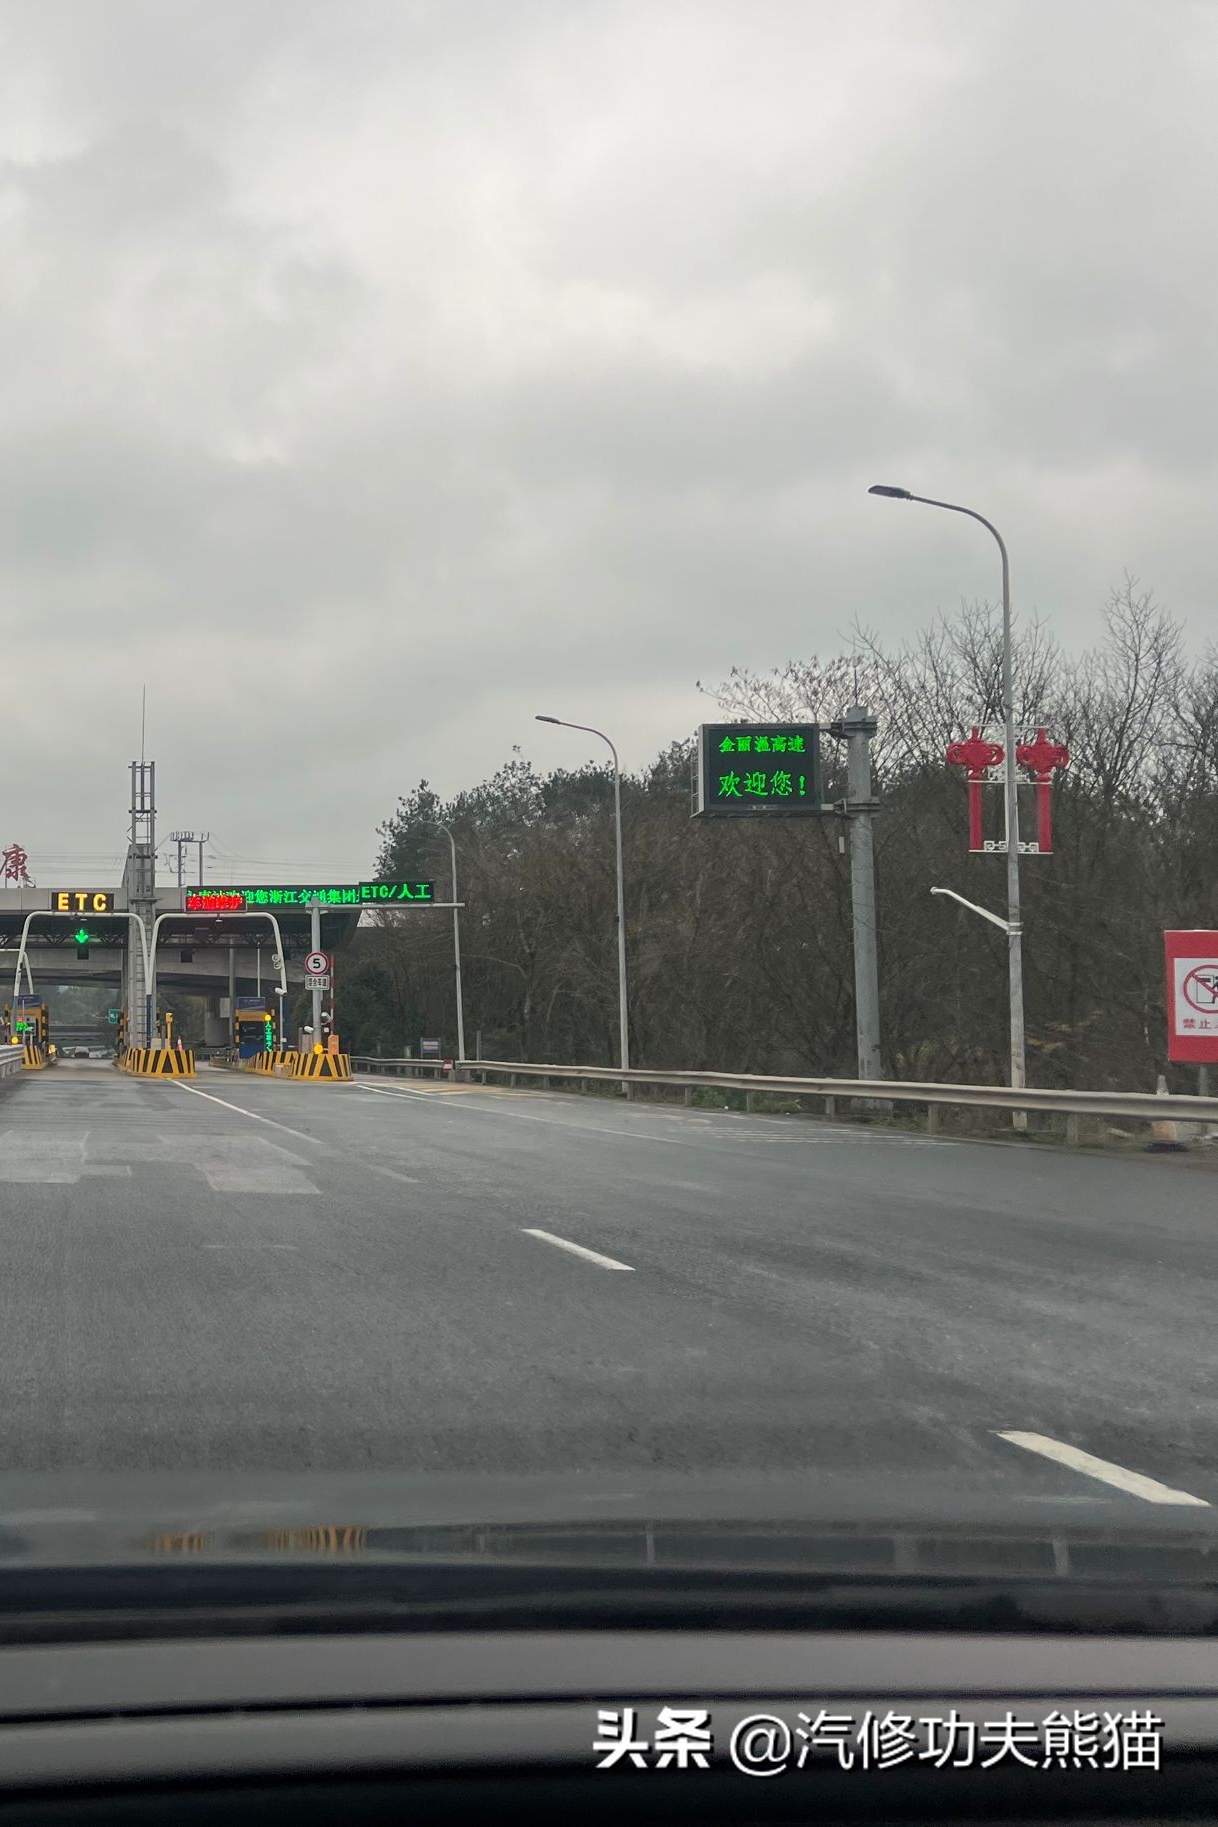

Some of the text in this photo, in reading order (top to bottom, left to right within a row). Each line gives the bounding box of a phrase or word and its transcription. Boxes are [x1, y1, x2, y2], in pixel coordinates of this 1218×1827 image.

[719, 734, 806, 753] 金丽温高速
[718, 770, 806, 797] 欢迎您！
[361, 883, 432, 900] ETC/人工
[57, 892, 108, 912] ETC
[312, 958, 321, 969] 5
[1183, 1018, 1218, 1030] 禁止
